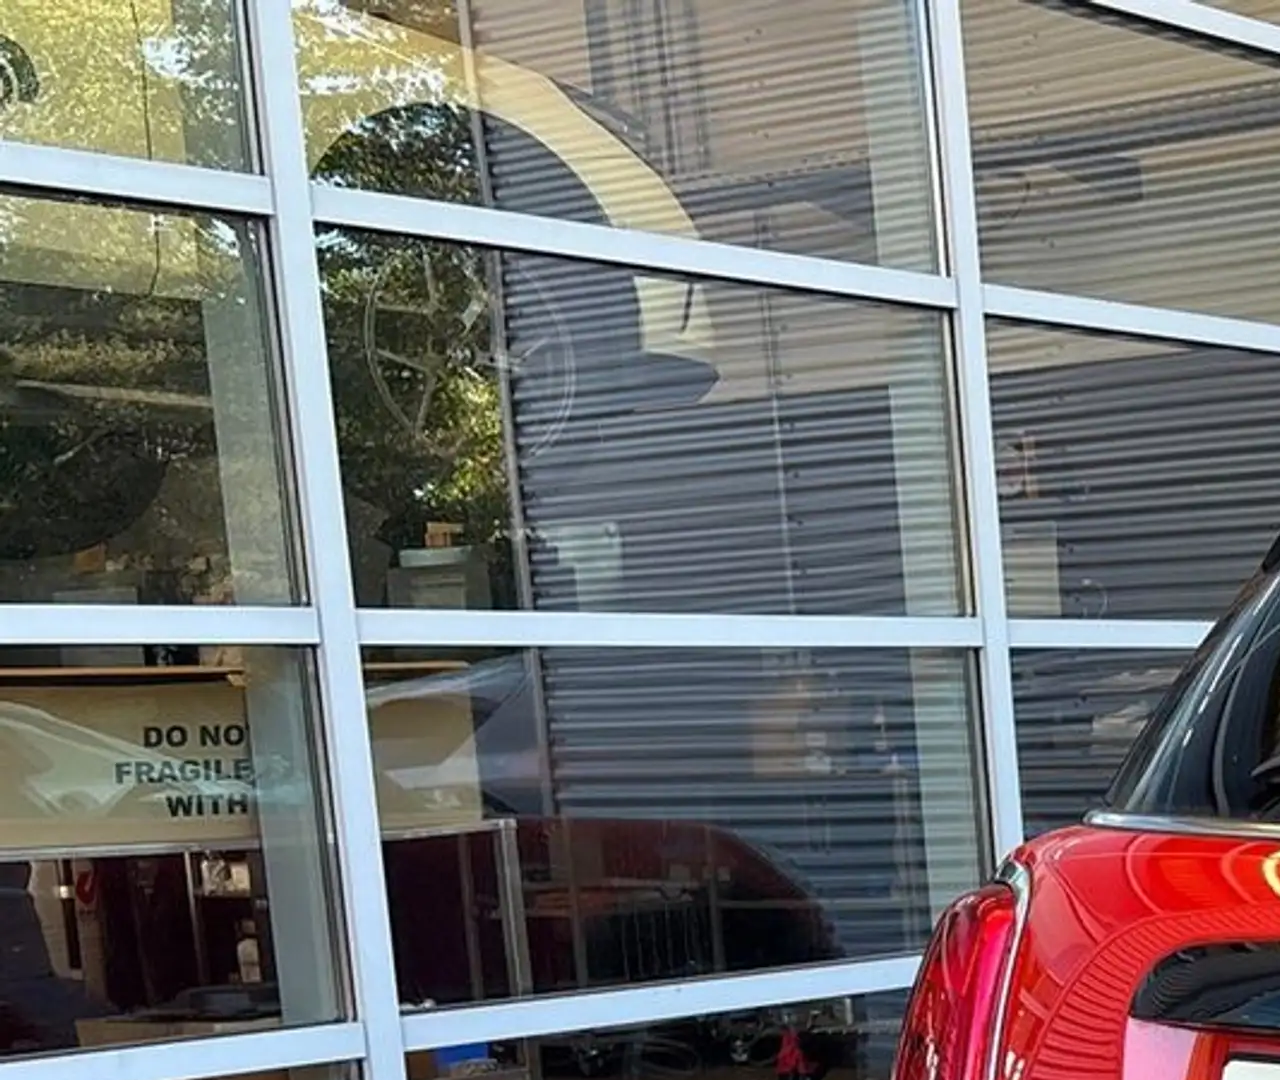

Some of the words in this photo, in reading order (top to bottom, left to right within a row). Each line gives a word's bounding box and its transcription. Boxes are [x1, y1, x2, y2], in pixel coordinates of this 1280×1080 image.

[143, 725, 188, 748] DO
[200, 724, 251, 747] NO
[166, 793, 248, 817] WITH
